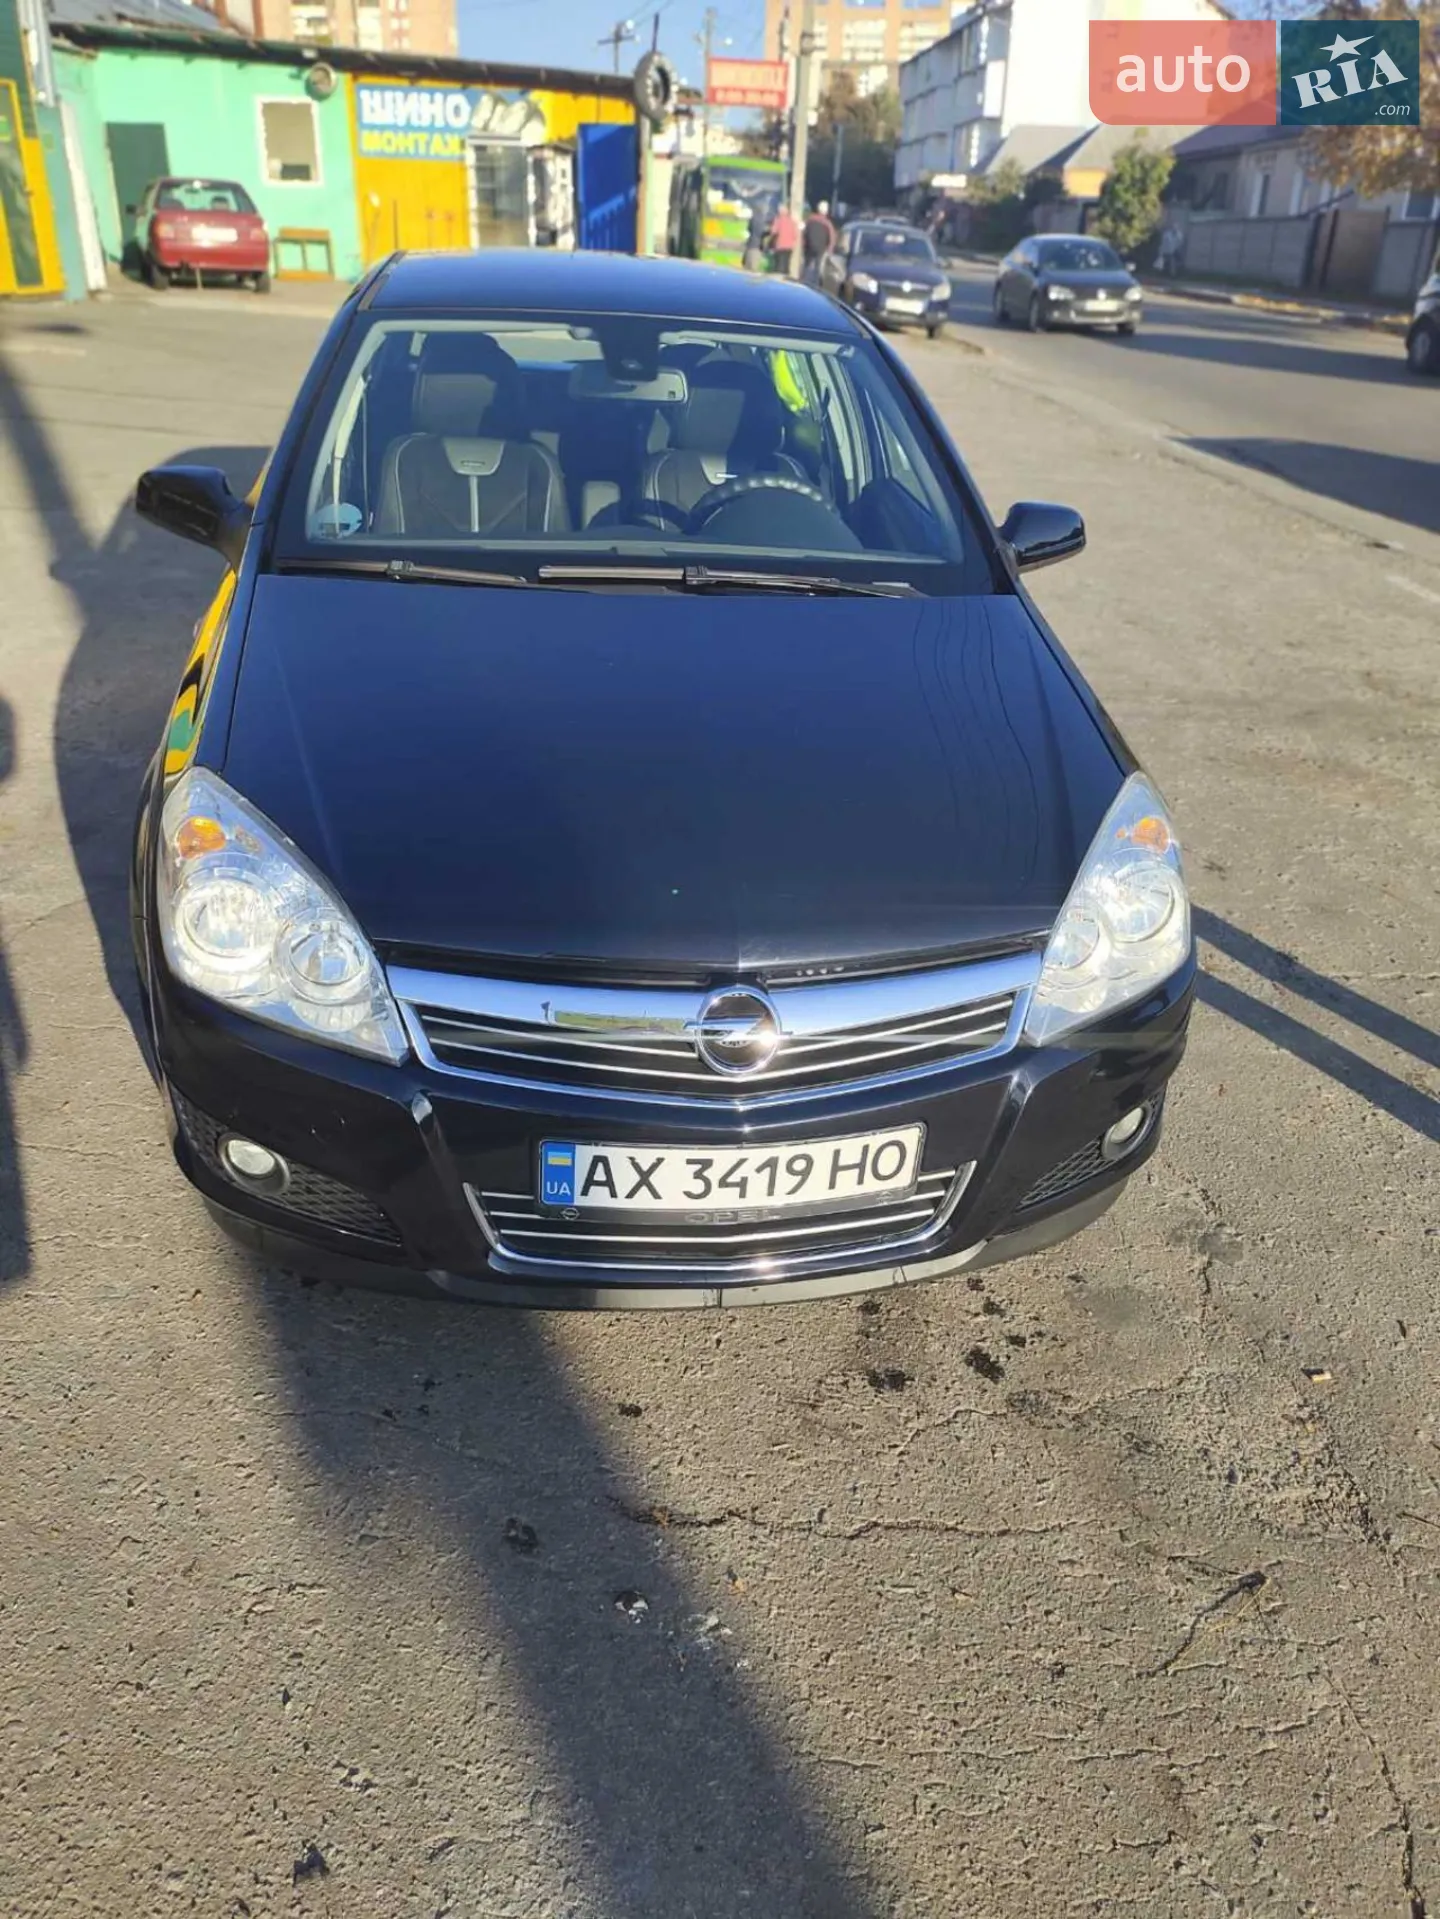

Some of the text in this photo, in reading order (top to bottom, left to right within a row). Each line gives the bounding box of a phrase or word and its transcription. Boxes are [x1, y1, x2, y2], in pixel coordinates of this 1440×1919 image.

[360, 88, 472, 129] ШИНО
[580, 1139, 907, 1201] AX 3419 HO
[546, 1180, 572, 1197] UA
[684, 1207, 782, 1225] OPEL
